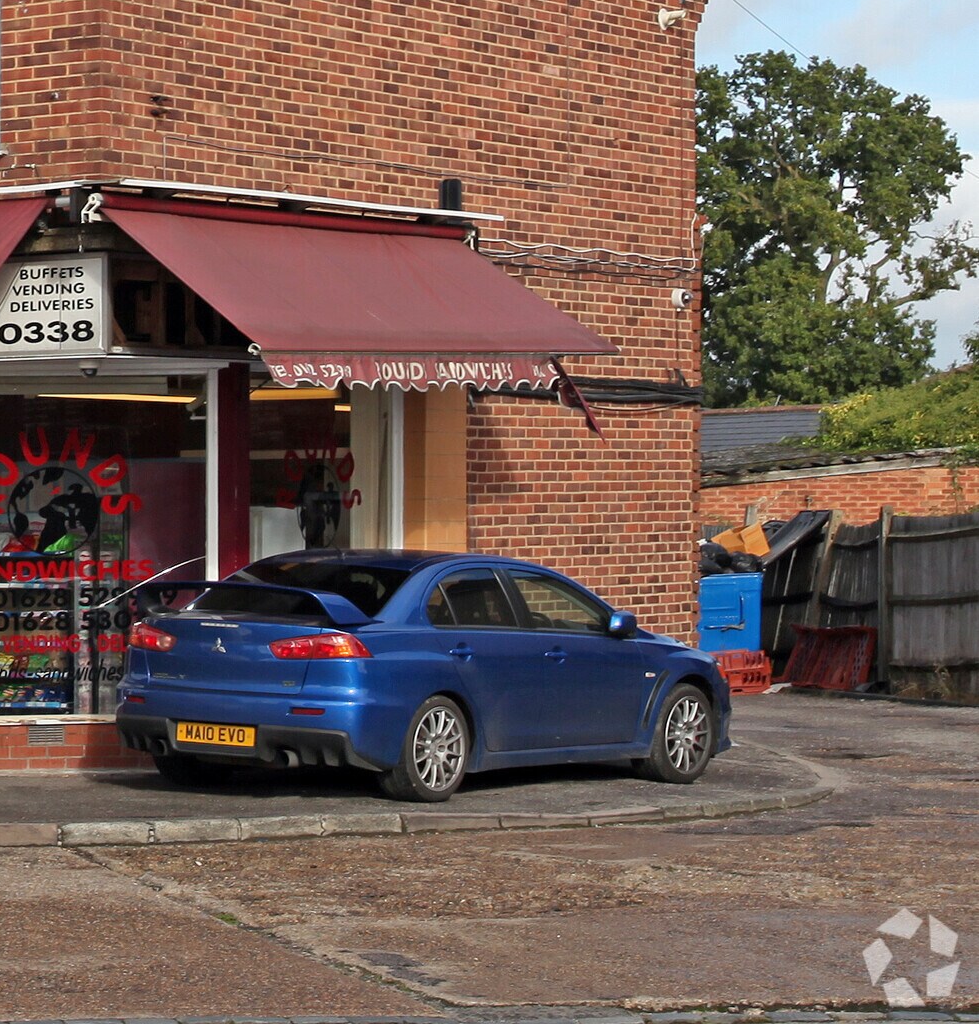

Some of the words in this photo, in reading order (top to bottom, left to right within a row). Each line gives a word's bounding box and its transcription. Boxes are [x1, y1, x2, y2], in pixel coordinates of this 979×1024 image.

[19, 267, 84, 280] BUFFETS
[12, 283, 85, 296] VENDING
[10, 298, 94, 312] DELIVERIES
[4, 633, 82, 654] VENDING
[218, 726, 246, 744] EVO
